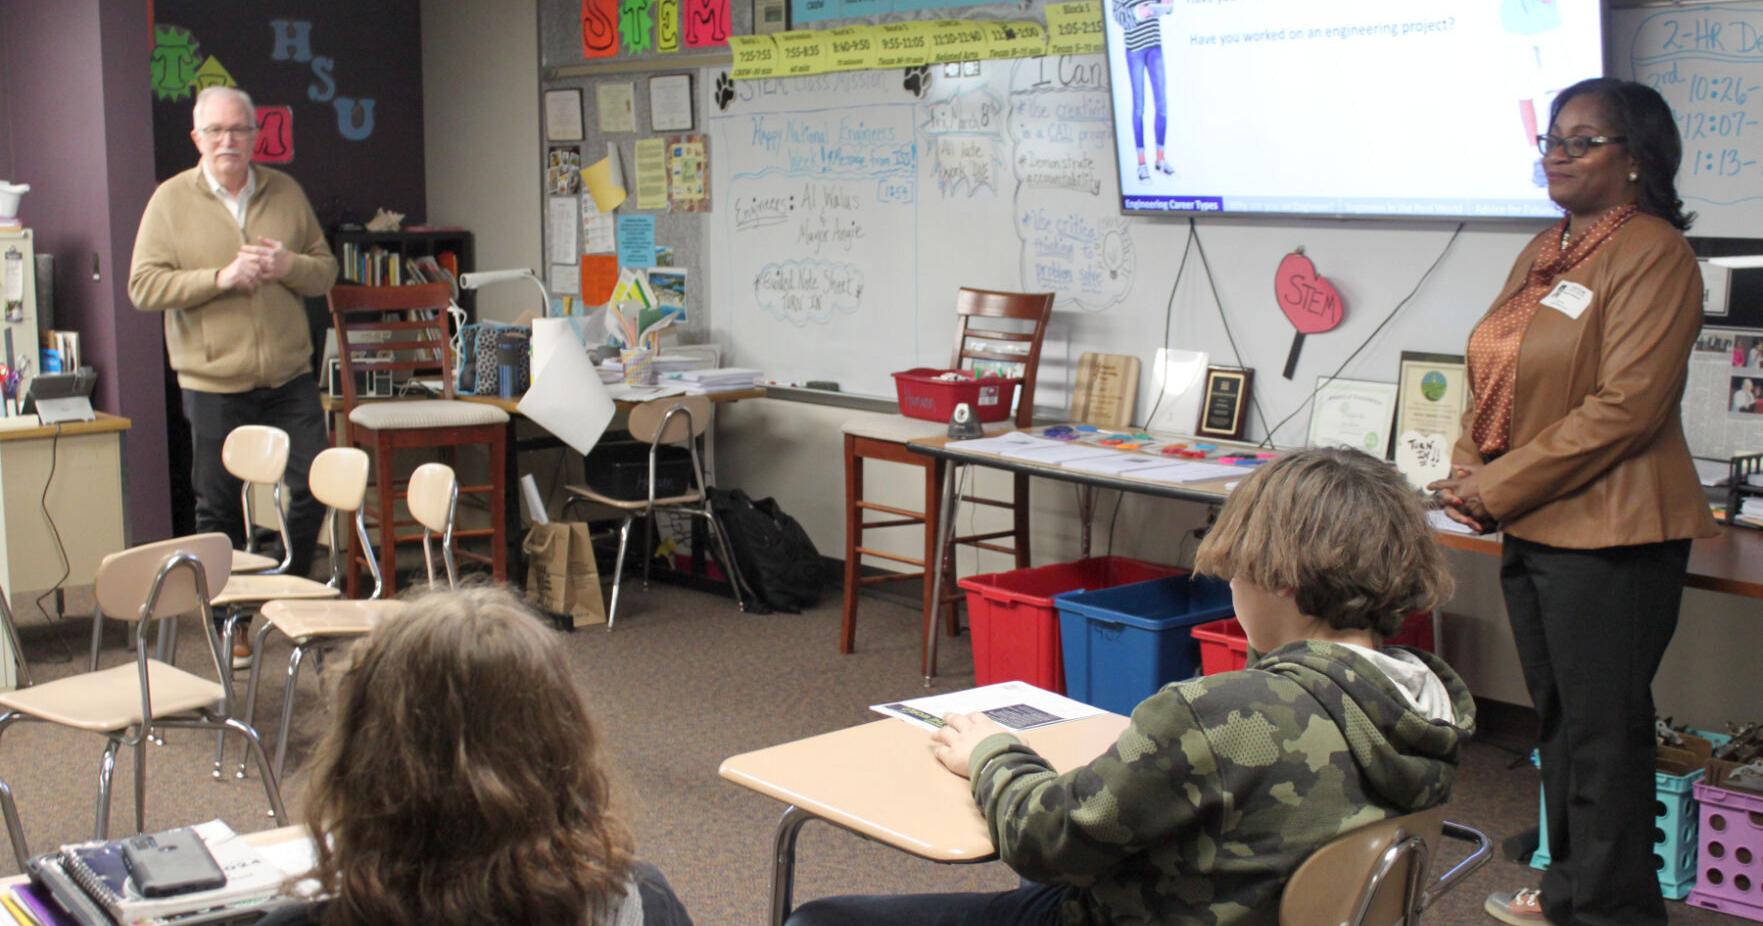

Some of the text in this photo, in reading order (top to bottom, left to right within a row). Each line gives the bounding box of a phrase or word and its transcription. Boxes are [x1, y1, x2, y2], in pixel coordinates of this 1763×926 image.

[583, 0, 726, 51] STEM
[1057, 20, 1103, 36] 1:05-2:15
[1190, 15, 1456, 46] Have you worked on an engineering project?
[1663, 17, 1724, 50] 2-HR
[1032, 52, 1100, 88] I Can
[751, 115, 783, 157] Happy
[786, 118, 829, 145] National
[1025, 151, 1095, 170] Demonstrate
[1125, 199, 1168, 211] Engineering
[1169, 199, 1195, 210] Career
[1195, 199, 1220, 211] Types
[1284, 273, 1335, 324] STEM
[1407, 438, 1434, 450] TURN
